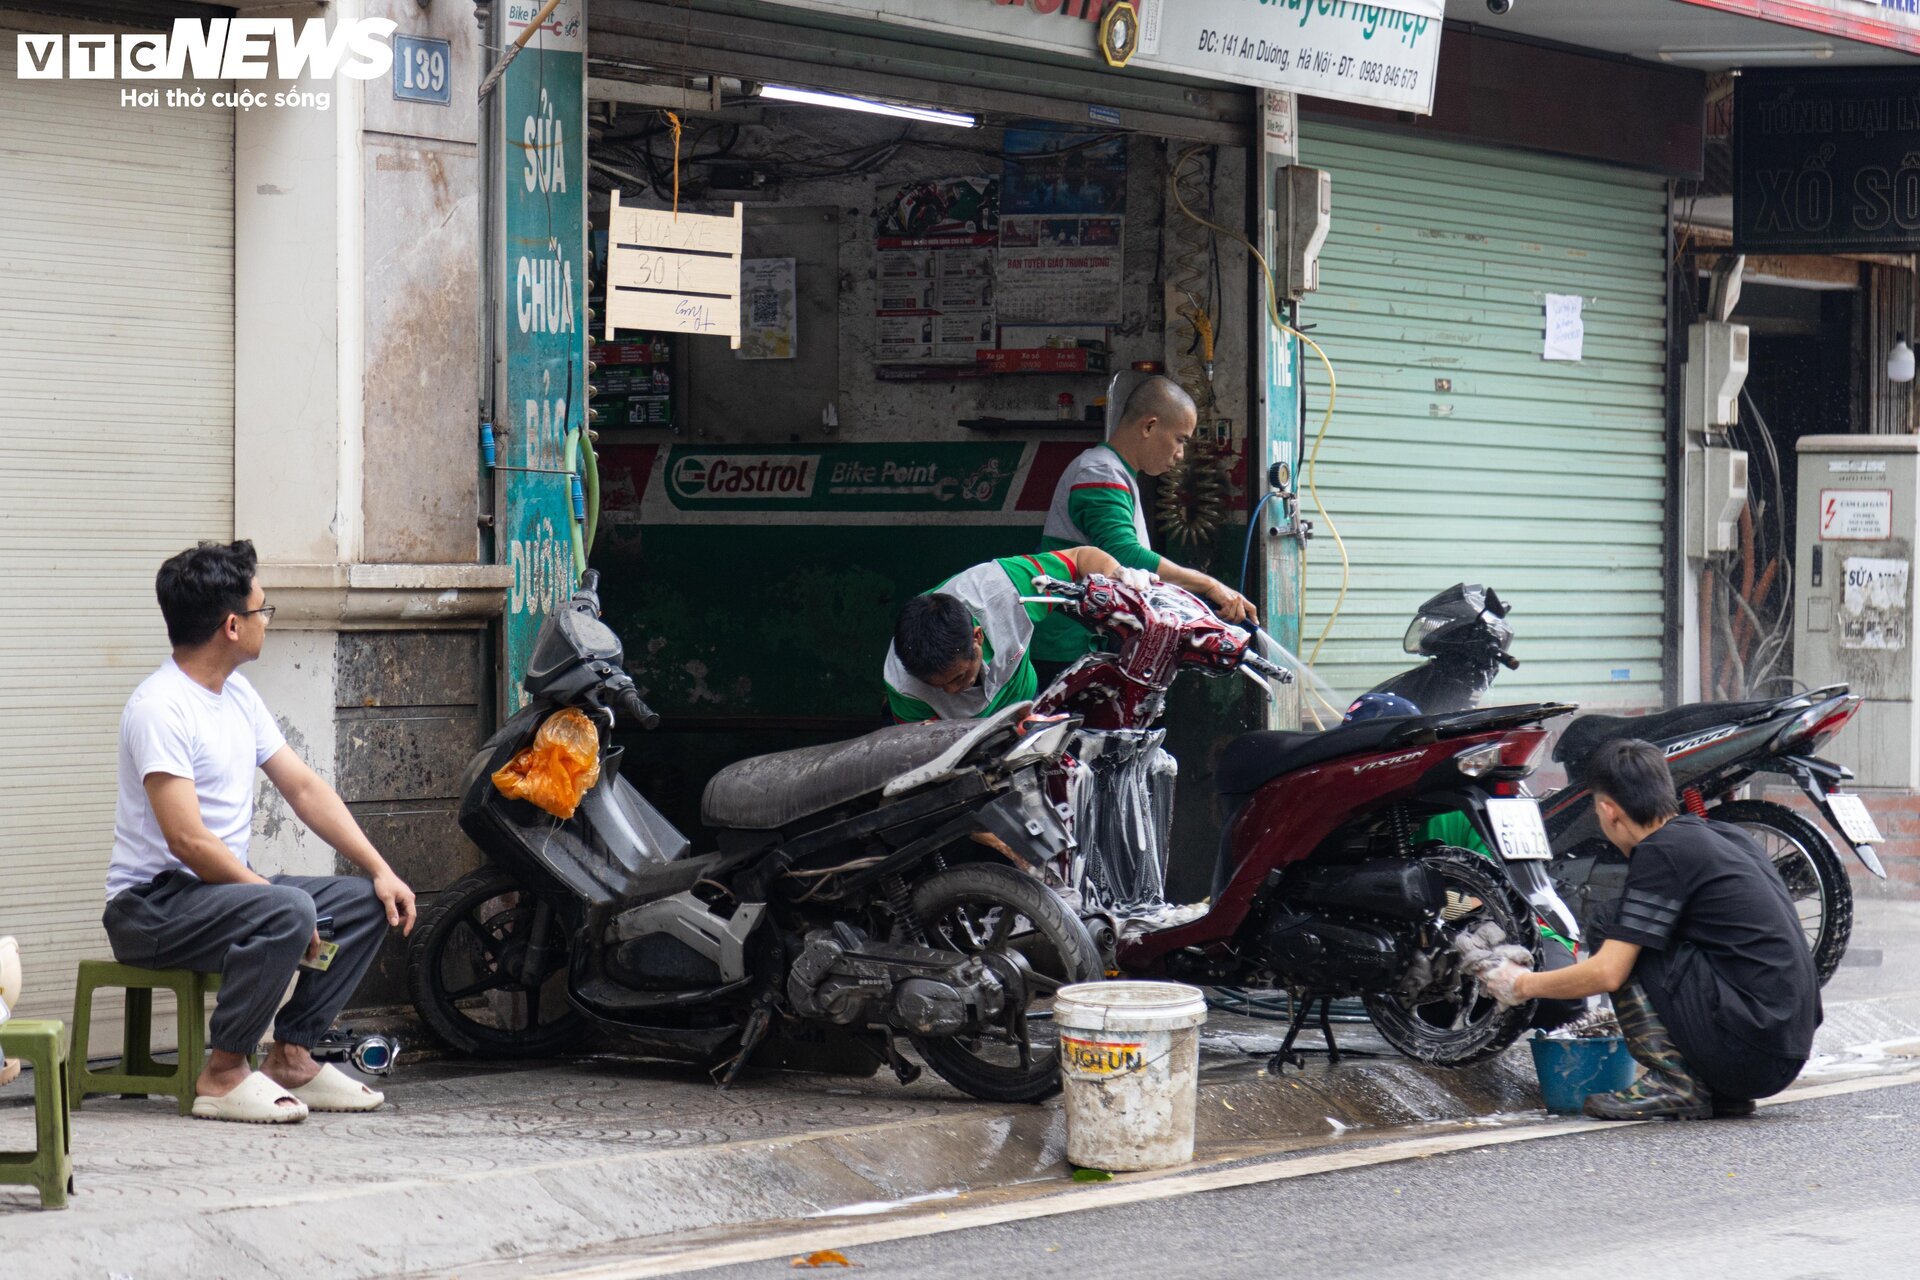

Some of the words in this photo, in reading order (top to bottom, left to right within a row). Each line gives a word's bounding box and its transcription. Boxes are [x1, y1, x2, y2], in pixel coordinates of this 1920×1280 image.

[509, 6, 529, 20] Bike
[530, 8, 555, 24] Pnt
[402, 47, 446, 92] 139
[1198, 30, 1219, 51] ĐC:
[1221, 34, 1239, 57] 141
[1239, 37, 1255, 60] An
[1256, 40, 1290, 71] Dương,
[1297, 47, 1310, 70] Hà
[1313, 50, 1331, 78] Nội
[1338, 55, 1355, 79] ĐT:
[1359, 60, 1382, 83] 0983
[1383, 63, 1400, 87] 846
[1401, 67, 1418, 90] 673
[524, 88, 567, 193] SỬA
[684, 220, 713, 247] XE
[517, 237, 575, 334] CHỮA
[633, 253, 665, 285] 30
[708, 460, 807, 492] Castrol
[830, 461, 877, 483] Bike
[881, 460, 938, 483] Point
